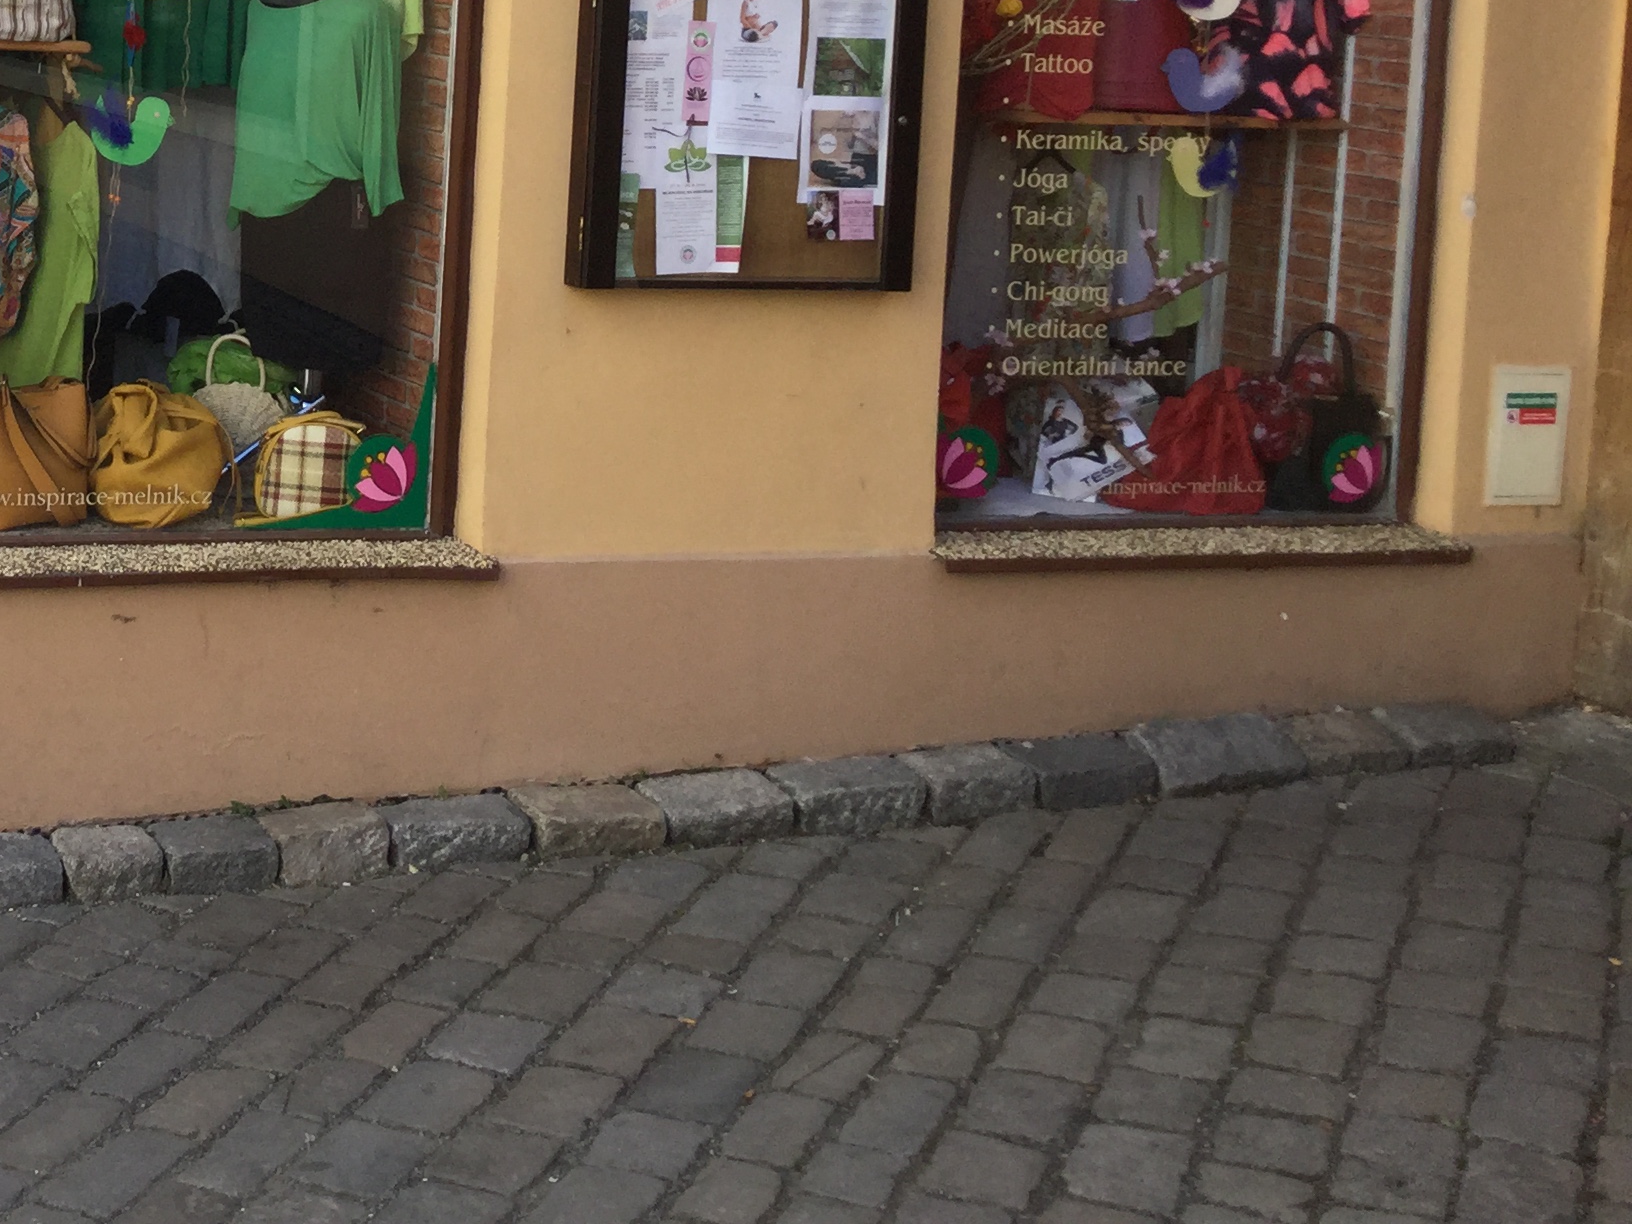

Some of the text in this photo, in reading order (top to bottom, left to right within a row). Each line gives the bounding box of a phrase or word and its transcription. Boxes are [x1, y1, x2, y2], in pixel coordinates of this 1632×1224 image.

[1023, 14, 1106, 37] Masáže
[1020, 52, 1094, 74] Tattoo
[1016, 129, 1211, 157] Keramika, špey
[1013, 167, 1068, 194] Jóga
[1011, 205, 1072, 226] Tai-či
[1010, 243, 1129, 270] Powerjóga
[1006, 280, 1109, 307] Chi-gong
[1005, 318, 1108, 339] Meditace
[1002, 355, 1187, 376] Orientální tance
